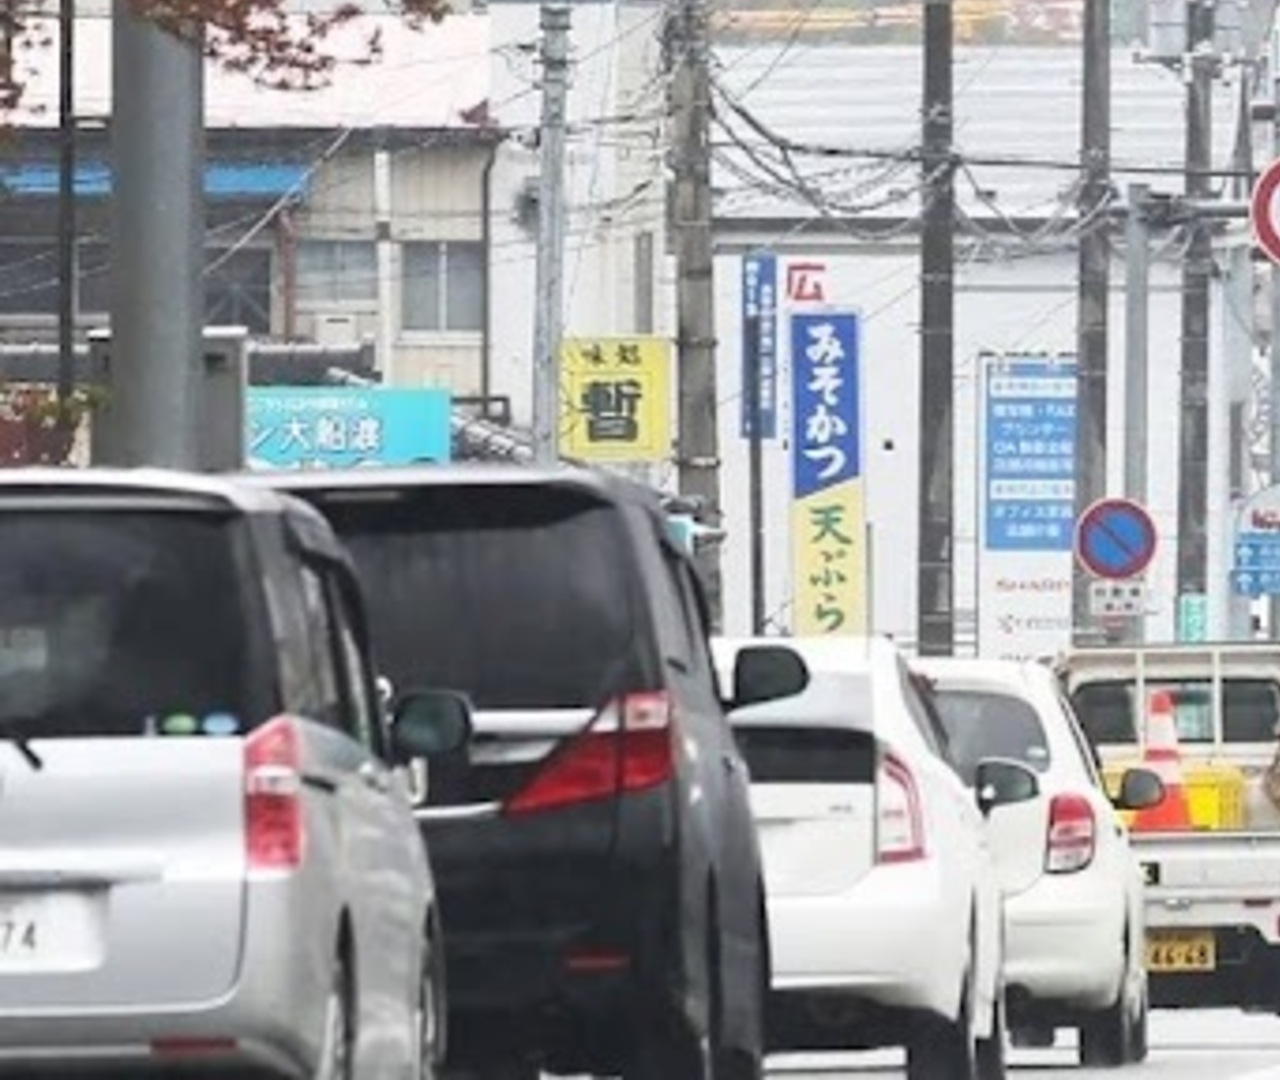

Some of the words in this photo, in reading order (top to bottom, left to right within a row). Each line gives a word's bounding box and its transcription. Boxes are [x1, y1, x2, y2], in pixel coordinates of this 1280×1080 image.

[803, 322, 848, 480] みそかつ
[809, 503, 852, 633] 天ぷら
